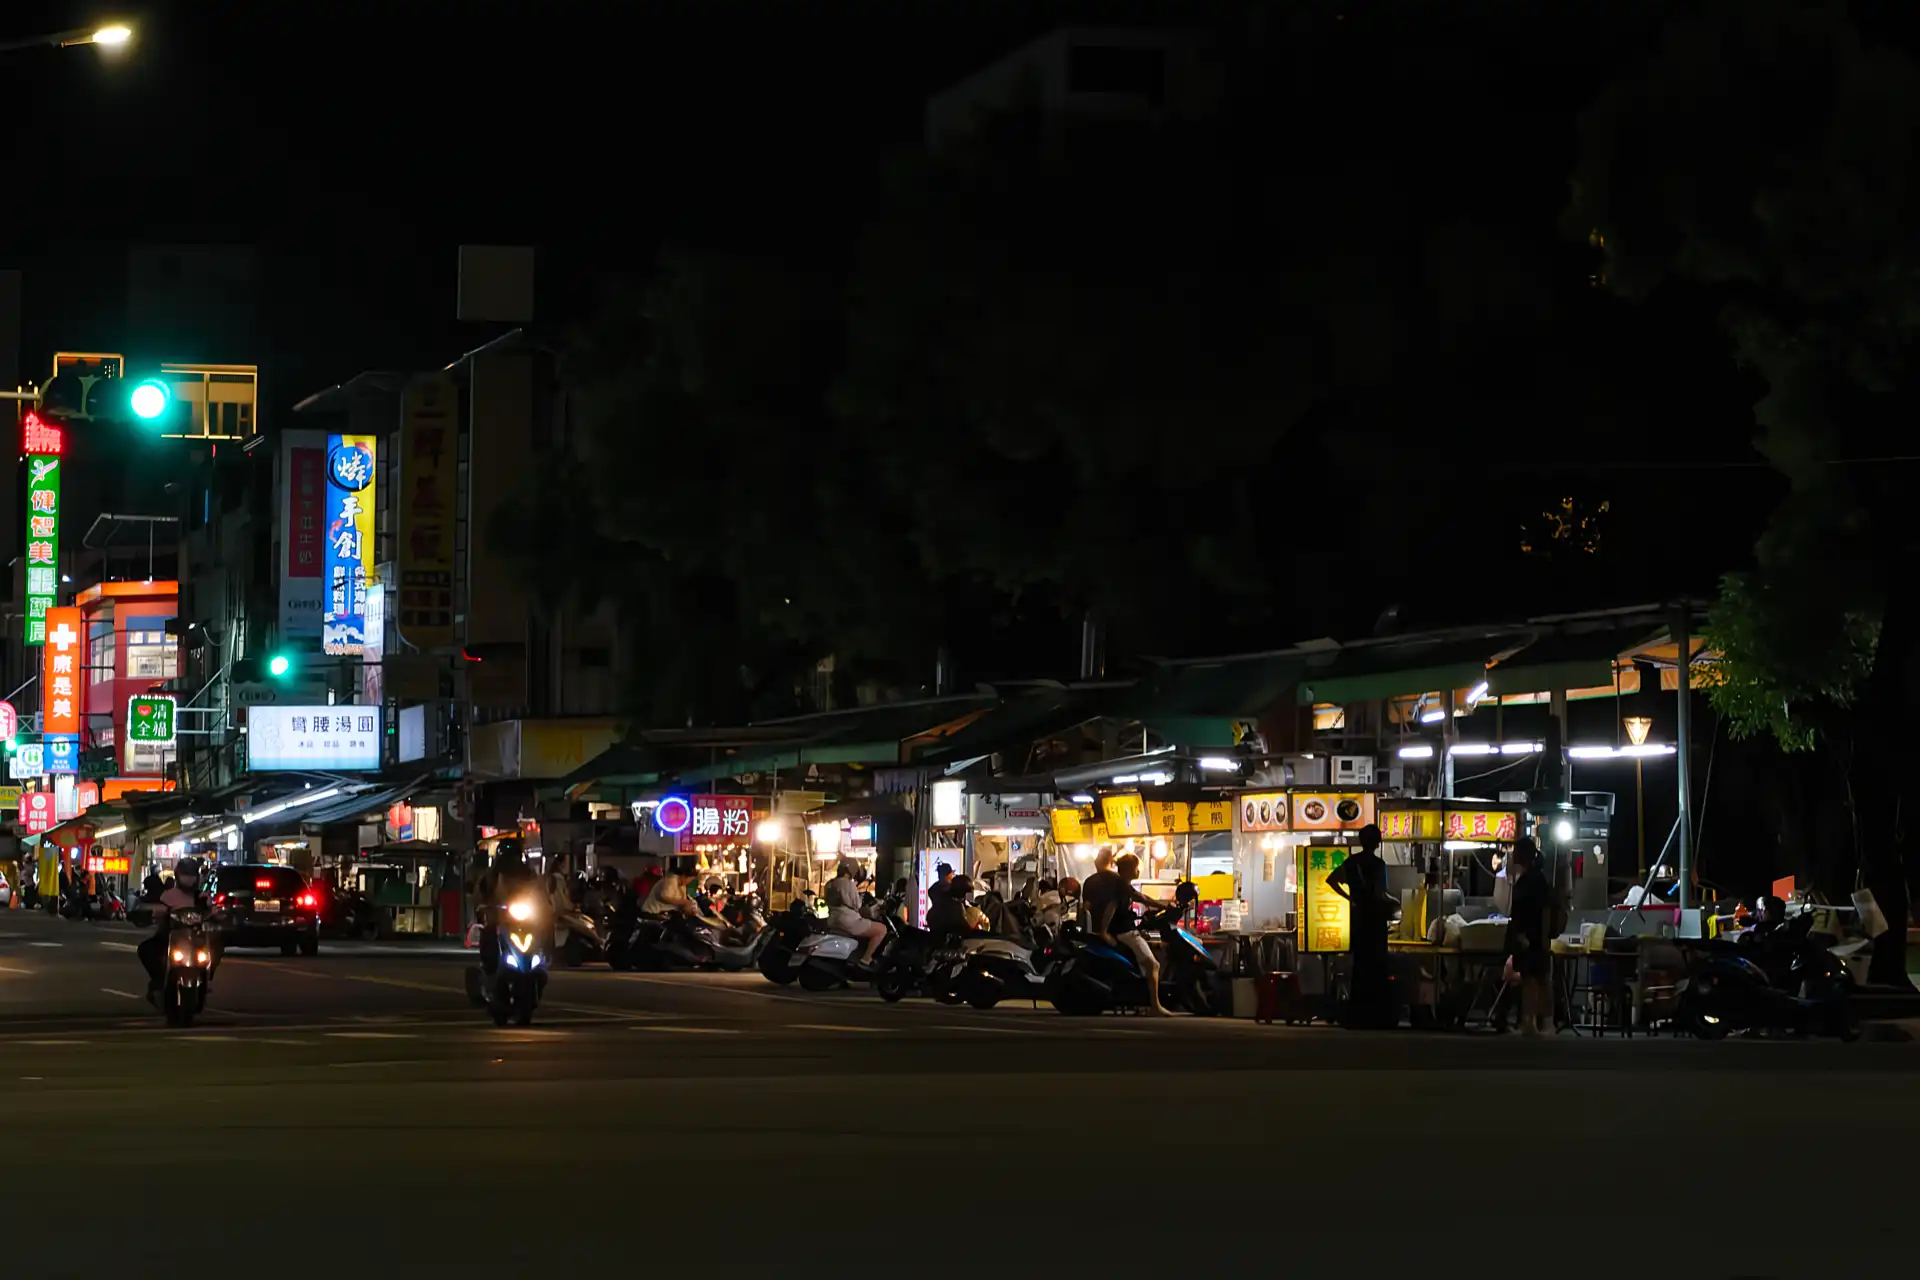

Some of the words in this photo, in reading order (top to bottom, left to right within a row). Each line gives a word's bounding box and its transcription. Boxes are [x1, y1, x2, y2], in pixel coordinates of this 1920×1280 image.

[52, 654, 73, 719] 康是美
[692, 806, 750, 836] 腸粉
[1446, 811, 1516, 839] 臭豆腐
